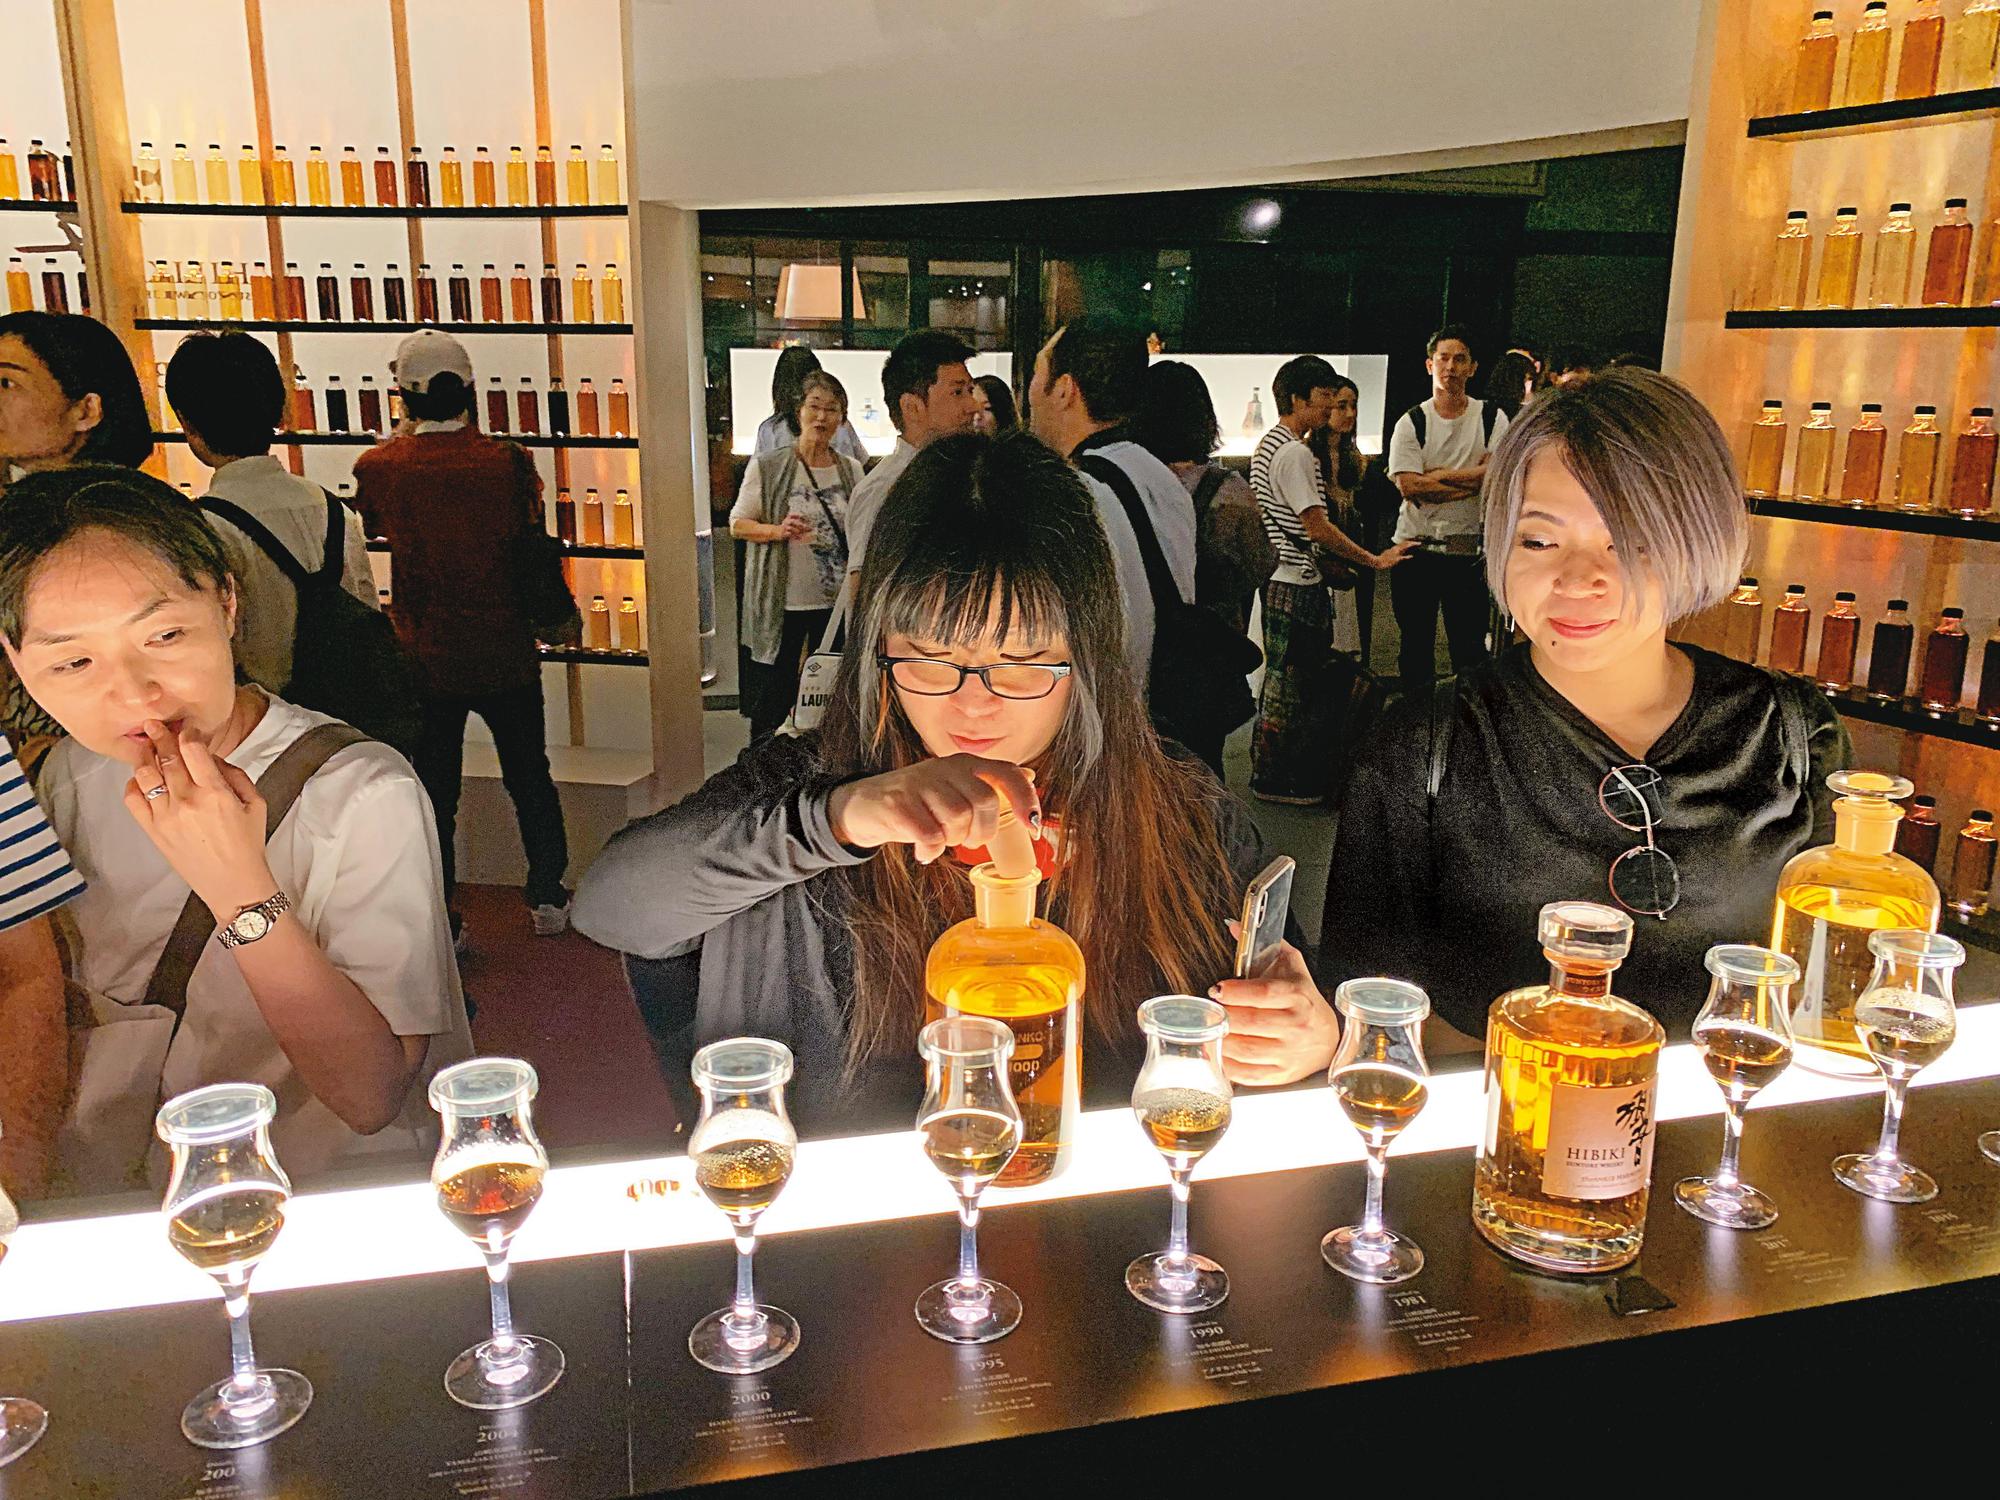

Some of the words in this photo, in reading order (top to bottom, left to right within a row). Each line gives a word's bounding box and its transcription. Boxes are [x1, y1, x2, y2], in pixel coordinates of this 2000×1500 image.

[1567, 1147, 1625, 1161] HIBIKI
[1190, 1326, 1224, 1339] 1990
[970, 1358, 1006, 1372] 1995
[730, 1391, 771, 1406] 2000
